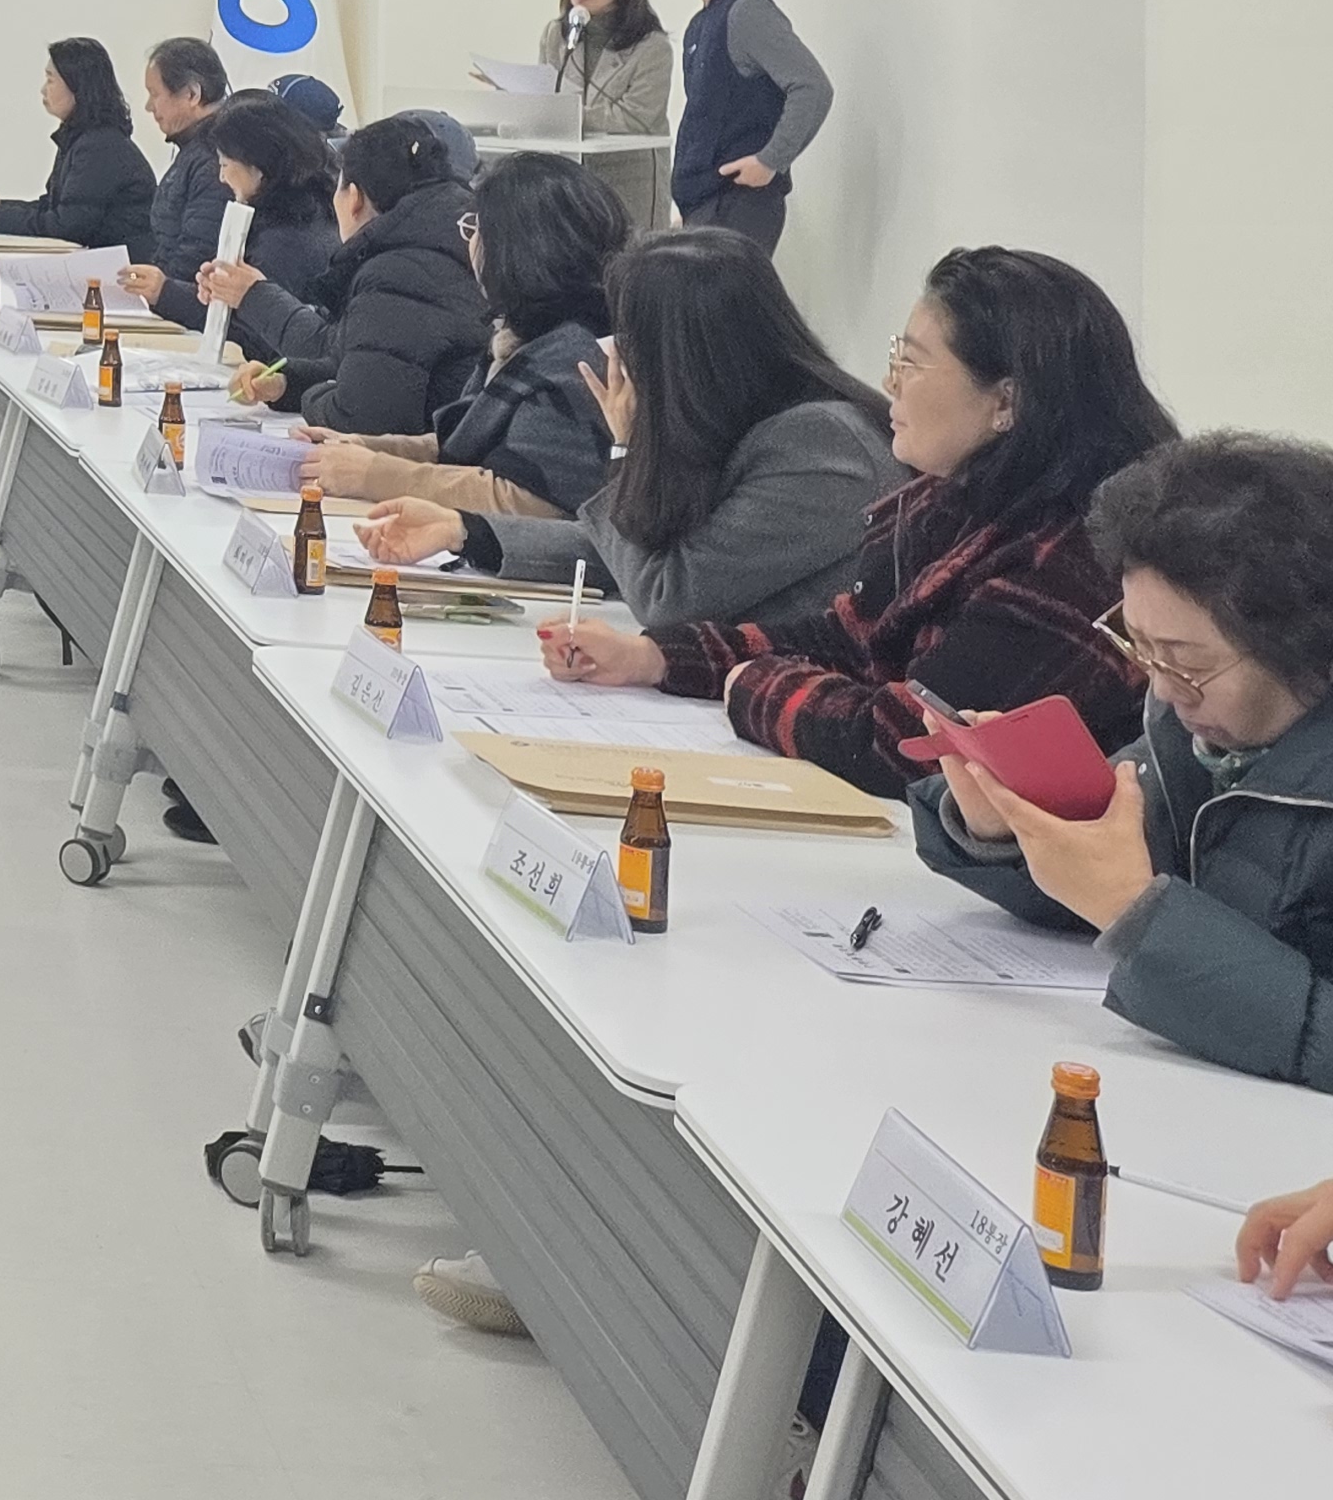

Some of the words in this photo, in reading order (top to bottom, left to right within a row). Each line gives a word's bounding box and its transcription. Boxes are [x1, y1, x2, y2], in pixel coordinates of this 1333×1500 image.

[509, 849, 563, 906] 조선희
[886, 1194, 959, 1283] 강혜선
[970, 1209, 1008, 1255] 18통장
